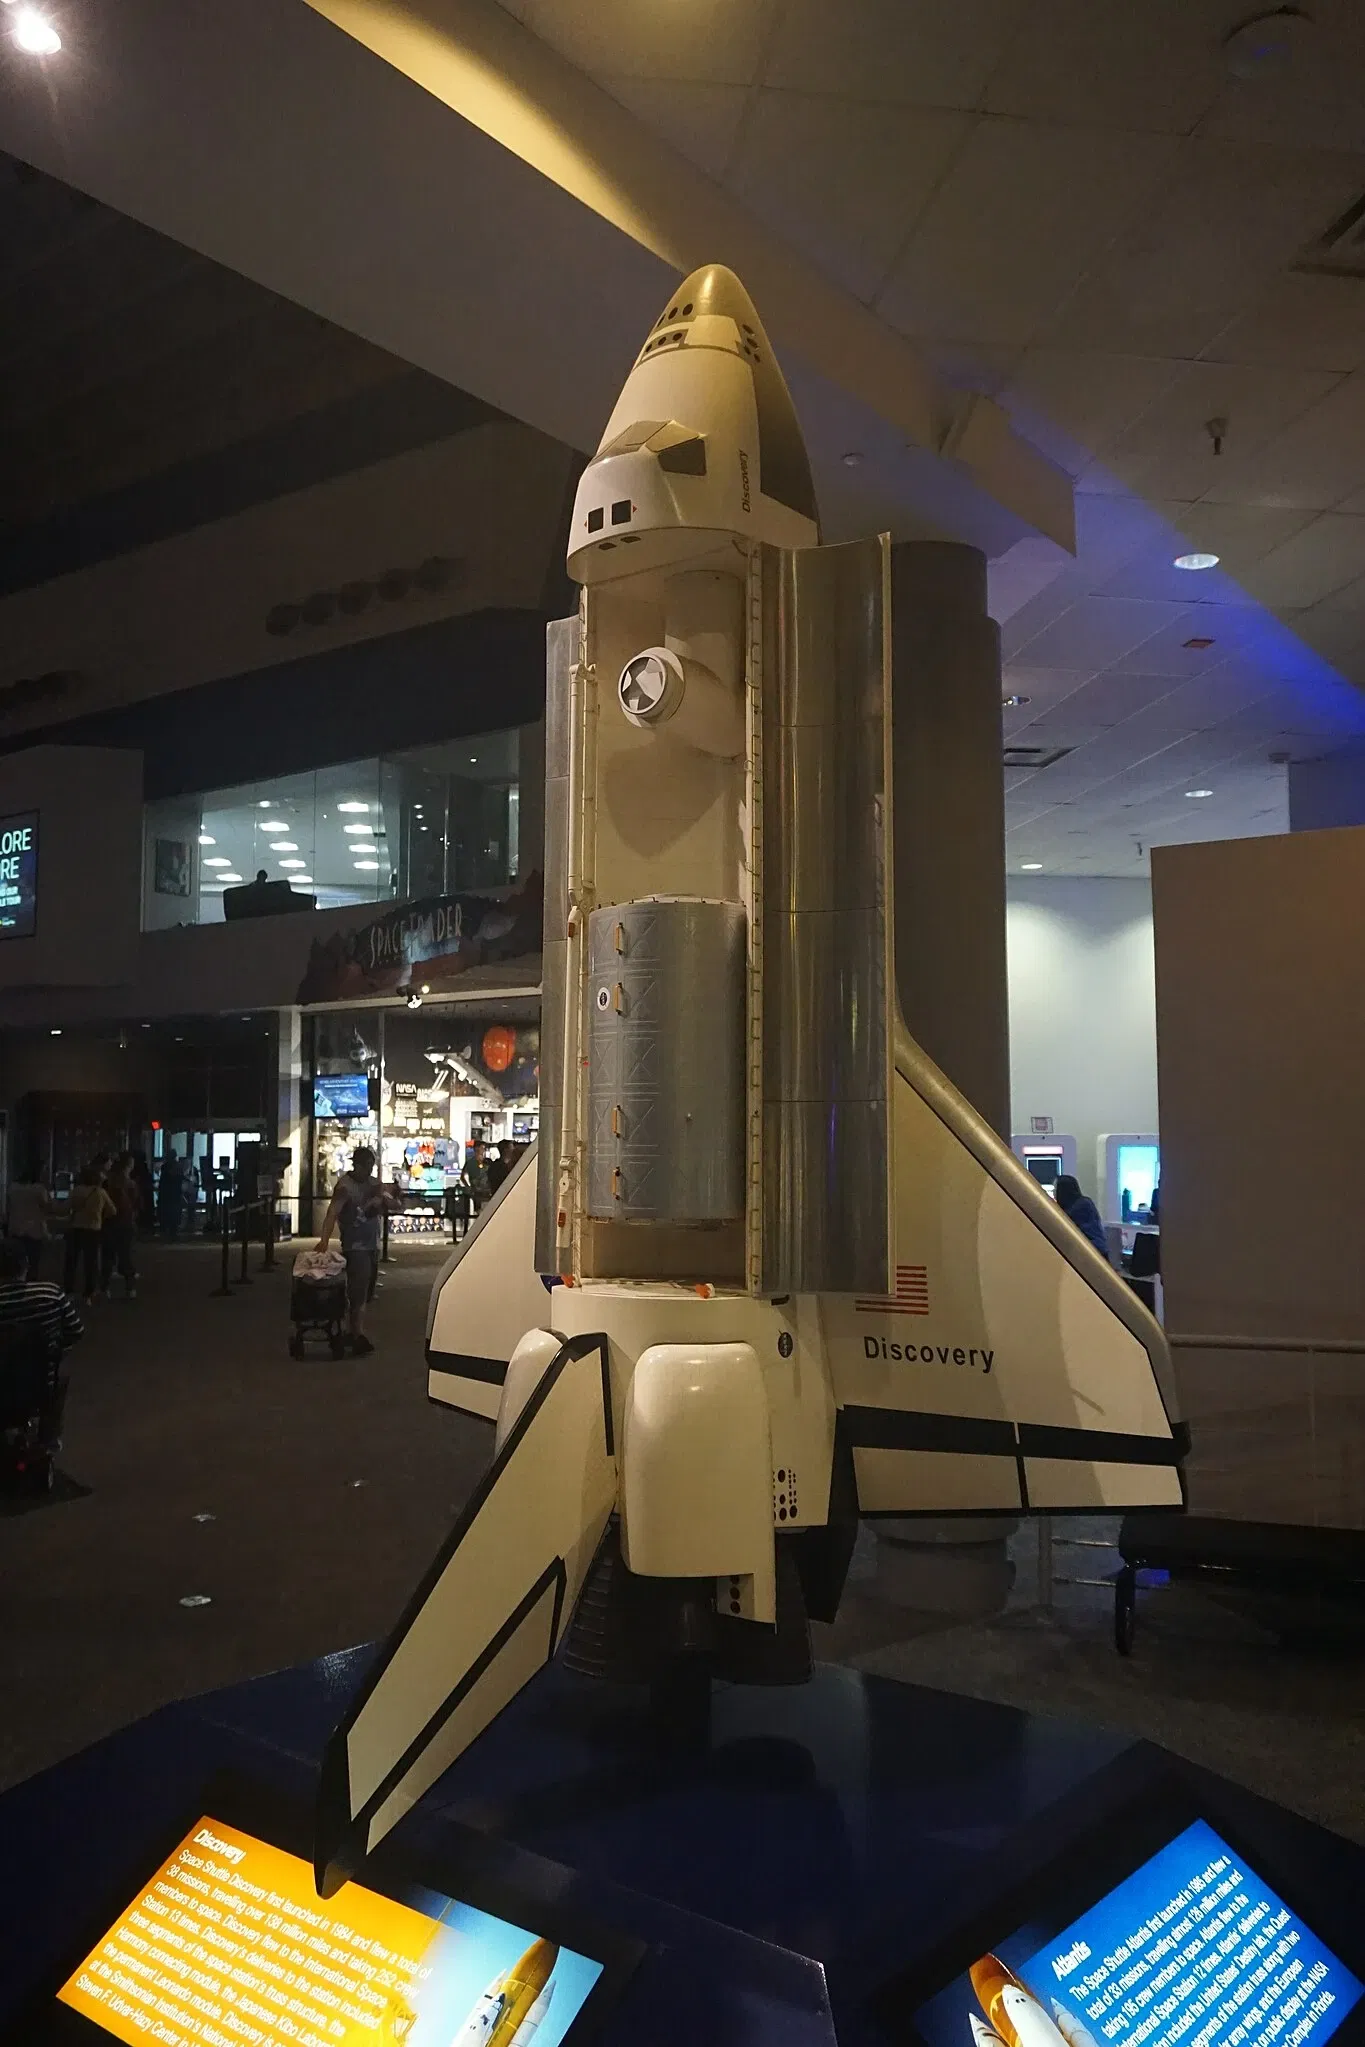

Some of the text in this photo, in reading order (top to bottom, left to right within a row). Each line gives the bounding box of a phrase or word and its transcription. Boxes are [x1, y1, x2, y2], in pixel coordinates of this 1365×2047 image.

[737, 448, 751, 513] Discovery
[0, 828, 32, 856] ORE
[370, 921, 407, 969] SPACE
[396, 1083, 417, 1093] NASA
[864, 1336, 994, 1374] Discovery
[194, 1829, 245, 1864] Discovery
[1215, 1880, 1233, 1898] miles
[1228, 1869, 1243, 1886] and
[179, 1849, 435, 1979] Space Shuttle Discovery first launched in 1984 and flew a total of
[1187, 1906, 1204, 1923] 126
[1199, 1893, 1220, 1914] million
[166, 1864, 180, 1877] 38
[177, 1871, 210, 1895] missions,
[244, 1906, 265, 1920] over
[264, 1913, 283, 1929] 138
[279, 1923, 308, 1943] million
[306, 1936, 331, 1954] miles
[328, 1948, 351, 1963] and
[348, 1956, 377, 1980] taking
[374, 1968, 397, 1986] 252
[394, 1980, 421, 1998] crew
[1069, 1855, 1231, 2001] The Space Shuttle Atlantis first launched in 1985 and flew a
[1171, 1916, 1194, 1941] almost
[1284, 1930, 1300, 1946] two
[155, 1882, 387, 2008] members to space. Discovery flew to the International Space
[1275, 1939, 1291, 1956] with
[142, 1895, 382, 2030] Station 13 times. Discovery's deliveries to the station included
[1052, 1941, 1091, 1980] Atlantis
[1101, 1893, 1249, 2038] taking 195 crew members to space. Atlantis flew to the
[1153, 1995, 1179, 2019] Space
[1172, 1975, 1199, 2000] Station
[1192, 1964, 1207, 1979] 12
[1200, 1952, 1222, 1972] times.
[1216, 1928, 1241, 1956] Atlantis'
[1237, 1907, 1264, 1935] deliveries
[1258, 1901, 1270, 1912] to
[1262, 1951, 1283, 1972] along
[1307, 1961, 1329, 1984] NASA
[116, 1927, 151, 1954] Harmony
[148, 1947, 192, 1978] connecting
[188, 1969, 221, 1995] module,
[220, 1986, 237, 2002] the
[234, 1995, 277, 2024] Japanese
[275, 2016, 298, 2037] Kibo
[129, 1911, 346, 2037] three segments of the space station's truss structure, the
[1118, 1960, 1152, 1990] missions,
[1164, 1908, 1291, 2043] included the United States' Destiny lab, the Quest
[1248, 1966, 1268, 1986] truss
[1300, 1978, 1316, 1993] the
[89, 1960, 101, 1971] at
[97, 1963, 113, 1979] the
[110, 1970, 157, 2005] Smithsonian
[154, 1998, 201, 2032] Institution's
[103, 1942, 118, 1957] the
[113, 1951, 157, 1980] permanent
[153, 1972, 192, 2001] Leonardo
[189, 1995, 222, 2019] module.
[221, 2011, 265, 2046] Discovery
[1102, 1989, 1114, 2006] of
[1107, 1982, 1123, 1999] 33
[1228, 2024, 1249, 2046] array
[1242, 2007, 1265, 2029] wings,
[1258, 1991, 1274, 2011] and
[1266, 1983, 1282, 1999] the
[1274, 1959, 1304, 1989] European
[1233, 1980, 1255, 2005] station
[1297, 1986, 1308, 2000] at
[76, 1974, 103, 1998] Steven
[100, 1989, 112, 2002] F.
[108, 1995, 154, 2031] Udvar-Hazy
[151, 2021, 180, 2046] Center
[1085, 1997, 1107, 2020] total
[1217, 2006, 1229, 2022] of
[1221, 1999, 1238, 2015] the
[1279, 1994, 1304, 2020] display
[1285, 1991, 1335, 2047] Complex in Florida.
[1257, 2033, 1271, 2047] on
[1265, 2014, 1285, 2041] public
